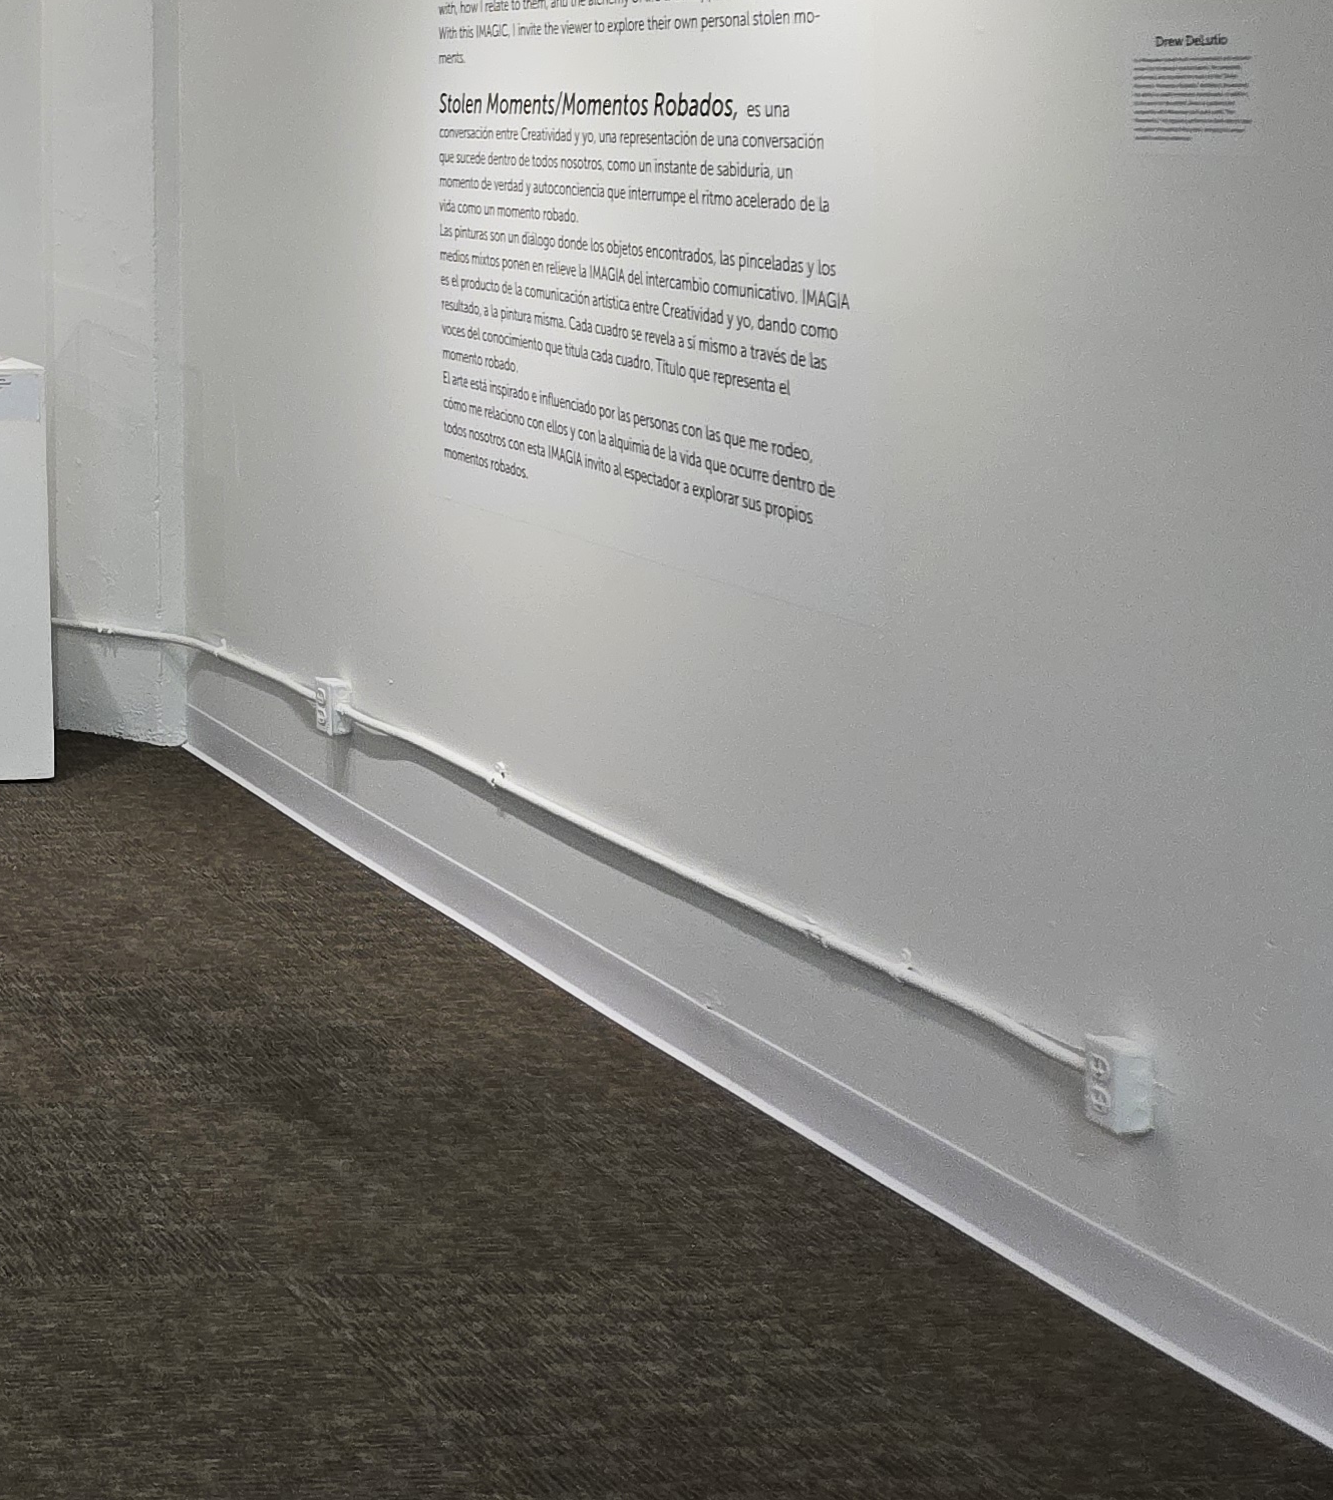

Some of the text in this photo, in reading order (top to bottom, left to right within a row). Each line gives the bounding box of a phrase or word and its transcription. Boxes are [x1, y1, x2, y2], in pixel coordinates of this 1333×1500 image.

[1155, 36, 1184, 47] Drew
[438, 90, 790, 121] Stolen Moments/Momentos Robados, es una
[438, 176, 830, 213] momento de verdad y autoconciencia que interrumpe el ritmo acelerado de la
[438, 198, 579, 223] vida como un momento robado.
[442, 349, 519, 374] momento robado.
[443, 447, 529, 480] momentos robados.
